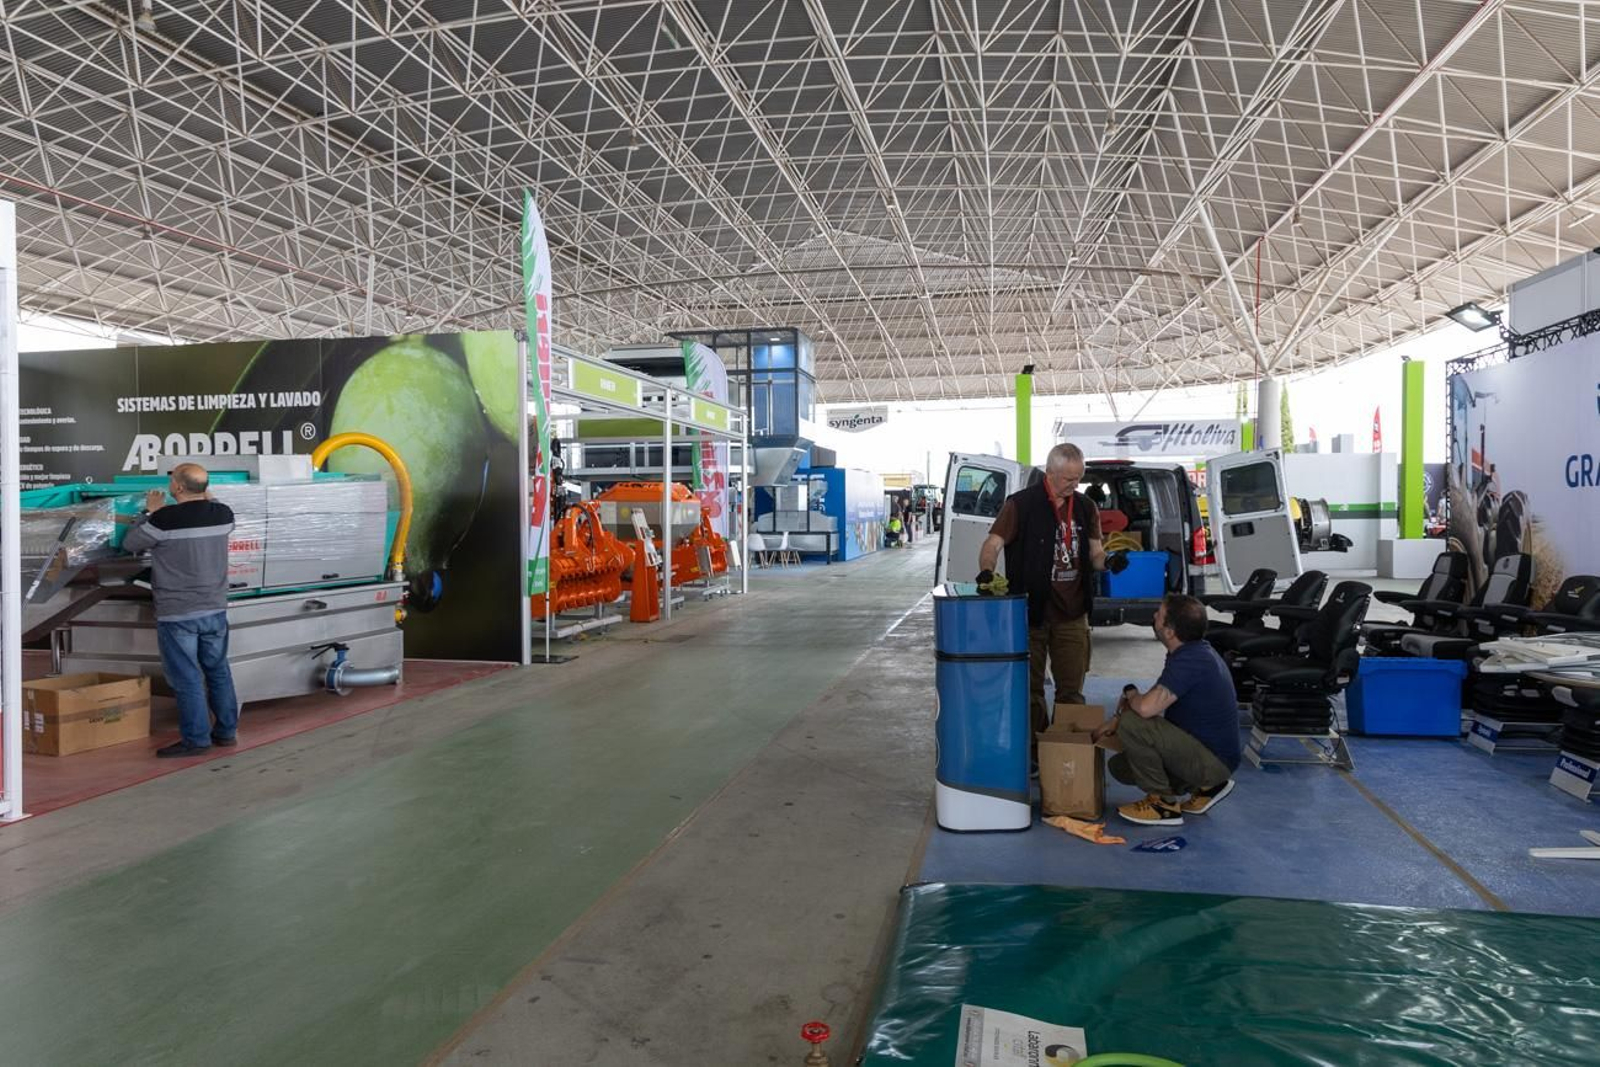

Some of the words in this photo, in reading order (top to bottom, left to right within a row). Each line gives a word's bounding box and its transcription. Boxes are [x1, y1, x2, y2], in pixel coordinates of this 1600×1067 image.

[117, 396, 176, 413] SISTEMAS
[179, 395, 195, 411] DE
[197, 393, 256, 410] LIMPIEZA
[258, 393, 268, 408] Y
[270, 391, 321, 408] LAVADO
[829, 416, 883, 429] syngenta
